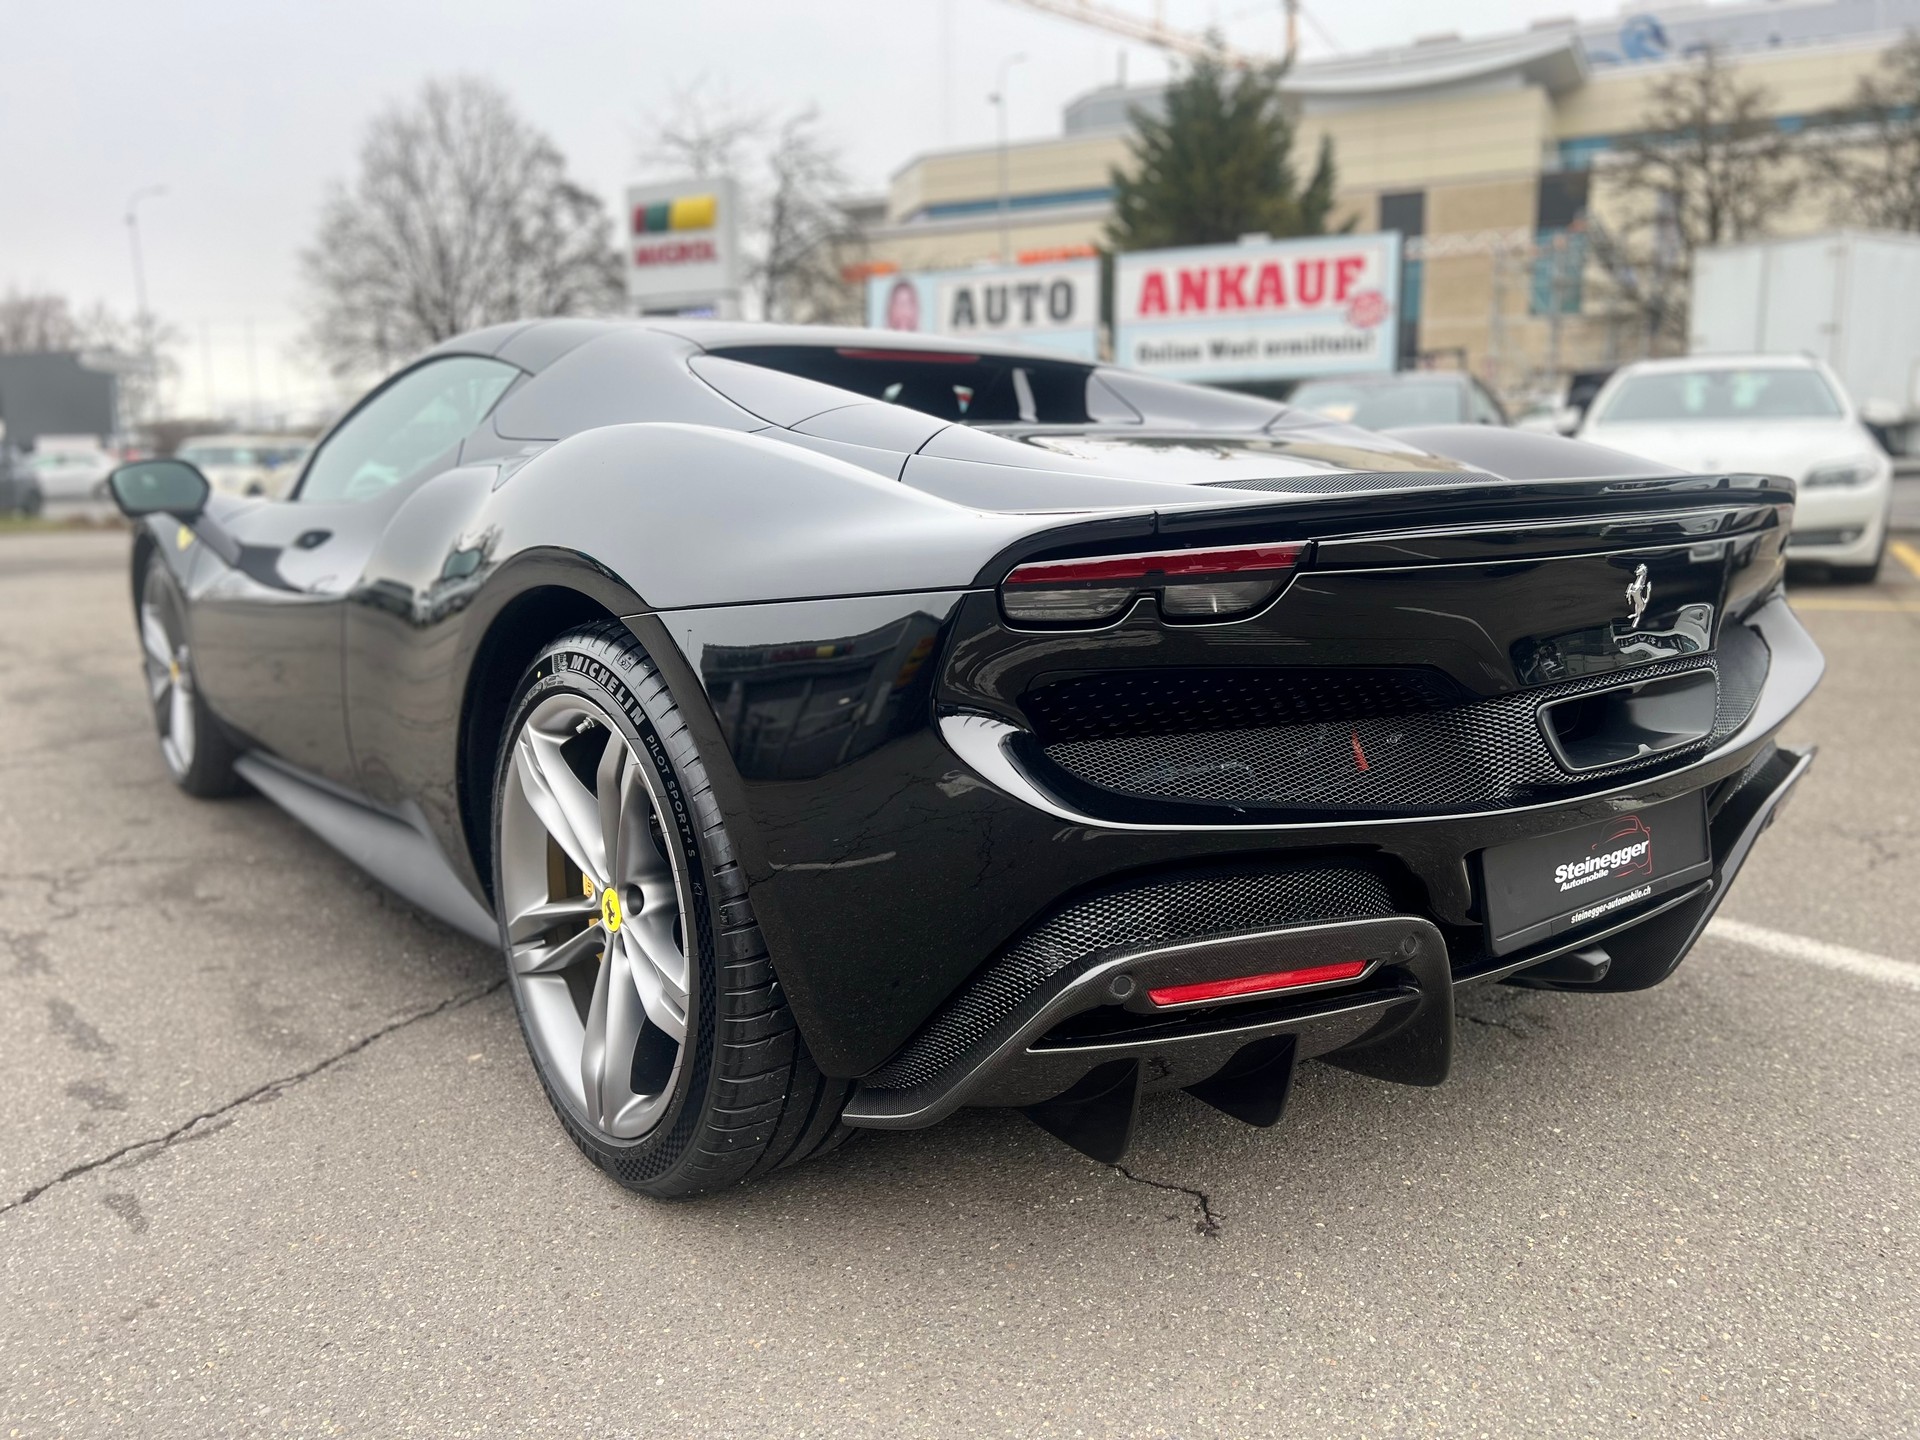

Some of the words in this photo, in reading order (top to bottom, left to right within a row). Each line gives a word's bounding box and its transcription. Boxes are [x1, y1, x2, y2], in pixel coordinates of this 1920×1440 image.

[951, 279, 1076, 328] AUTO
[1138, 253, 1366, 316] ANKAUF
[570, 655, 646, 726] MICHELIN
[646, 734, 670, 775] PILOT
[667, 780, 691, 835] SPORT
[1554, 840, 1649, 884] Steinegger
[1560, 869, 1609, 892] Automobile
[1570, 885, 1652, 924] steinegger-automobile.ch
